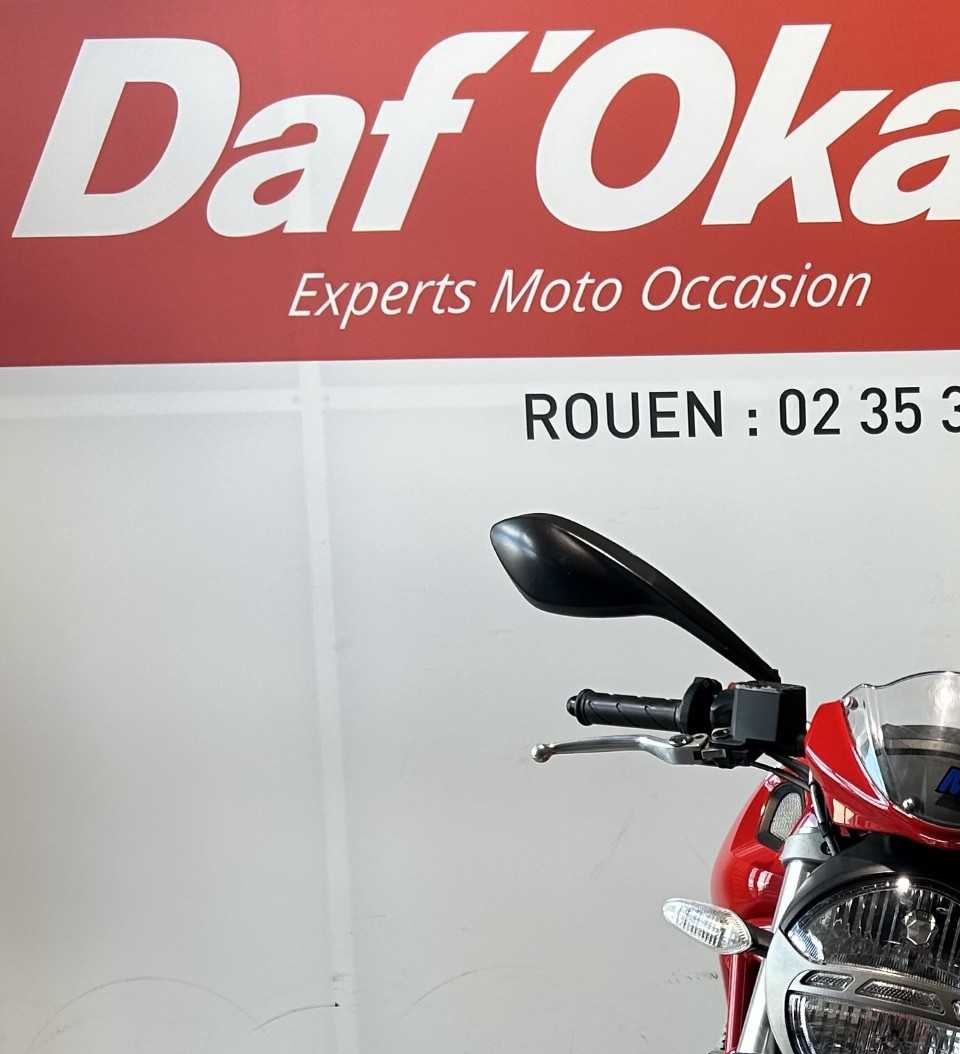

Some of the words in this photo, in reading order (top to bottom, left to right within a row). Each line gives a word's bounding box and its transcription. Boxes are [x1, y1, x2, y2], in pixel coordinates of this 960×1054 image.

[287, 272, 477, 330] Experts
[489, 268, 623, 313] Moto
[641, 262, 872, 311] Occasion
[524, 390, 723, 440] ROUEN
[748, 409, 758, 437] :
[779, 387, 841, 436] 02
[860, 386, 922, 435] 35
